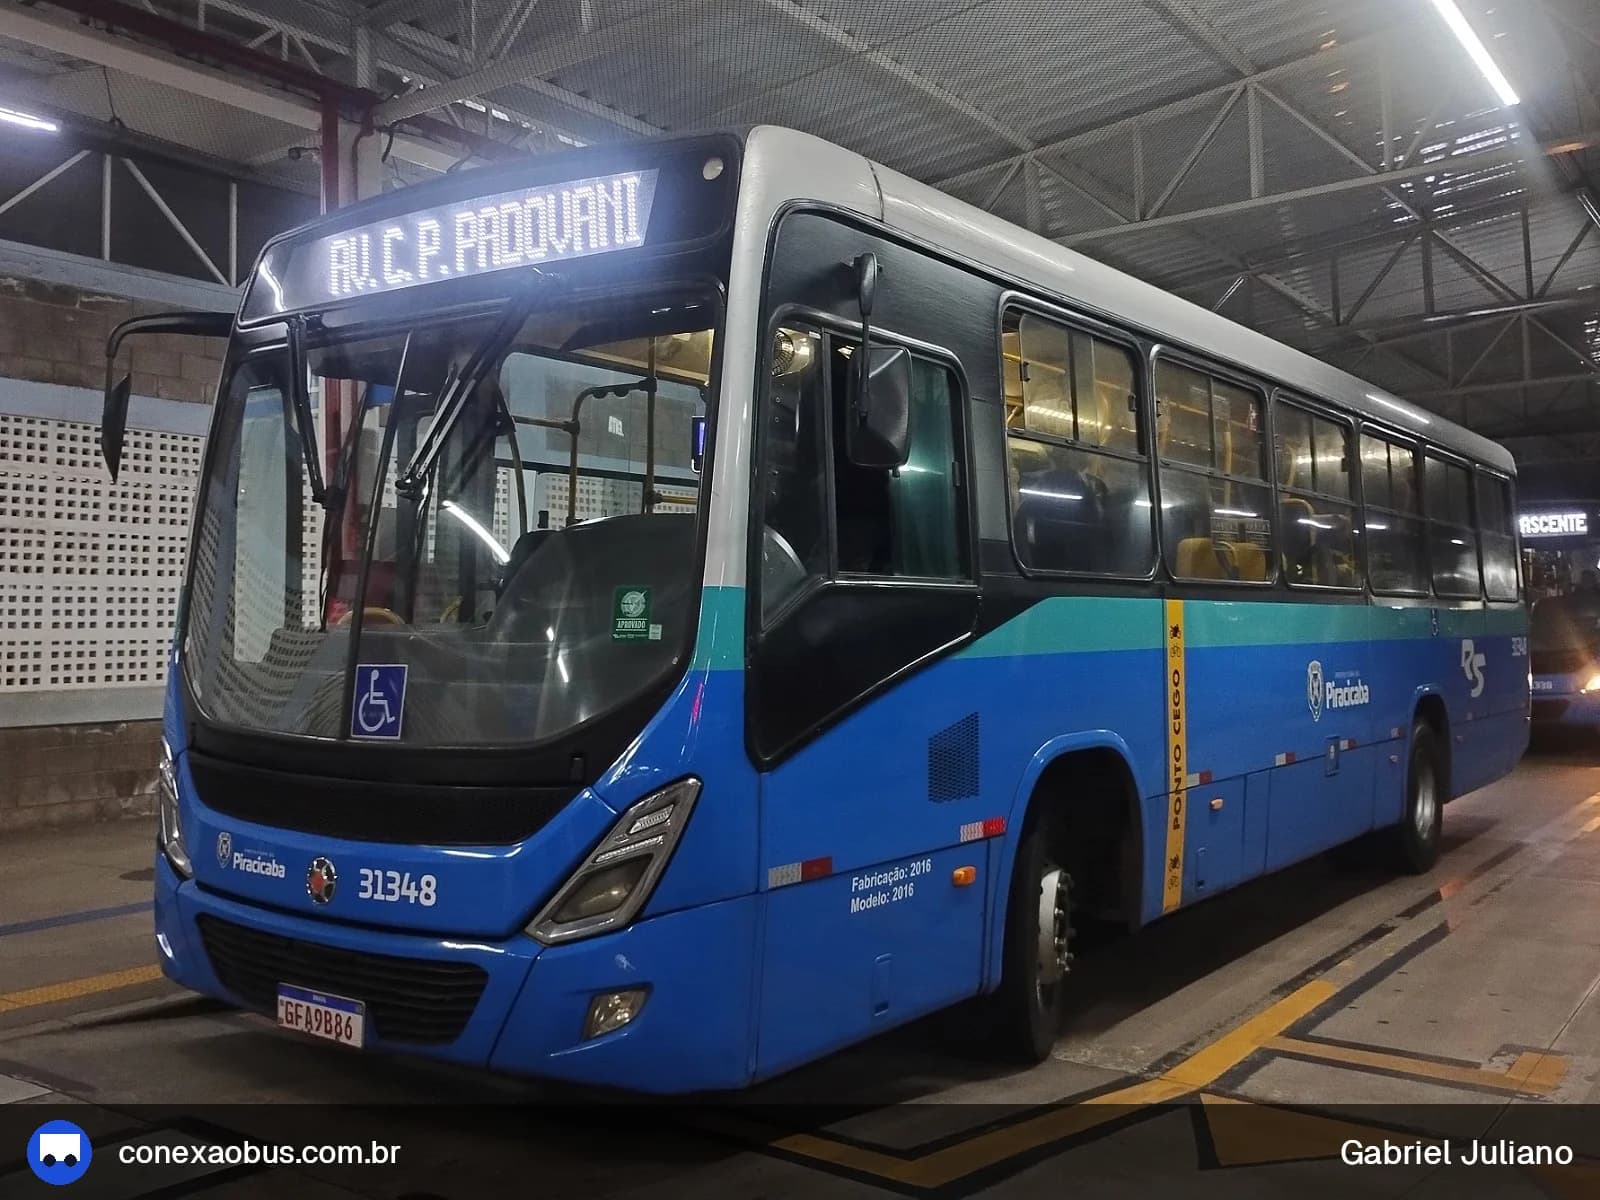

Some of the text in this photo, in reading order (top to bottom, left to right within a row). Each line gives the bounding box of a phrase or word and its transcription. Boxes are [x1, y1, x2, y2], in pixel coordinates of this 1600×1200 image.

[1519, 512, 1588, 534] ASCENTE
[1325, 679, 1370, 709] Piracicaba
[1172, 669, 1183, 831] PONTO CEGO
[232, 851, 286, 878] Piracicaba
[852, 858, 932, 892] Fabricação: 2016
[358, 868, 437, 907] 31348
[850, 882, 914, 914] Modelo: 2016
[285, 1000, 353, 1041] GFA9B86
